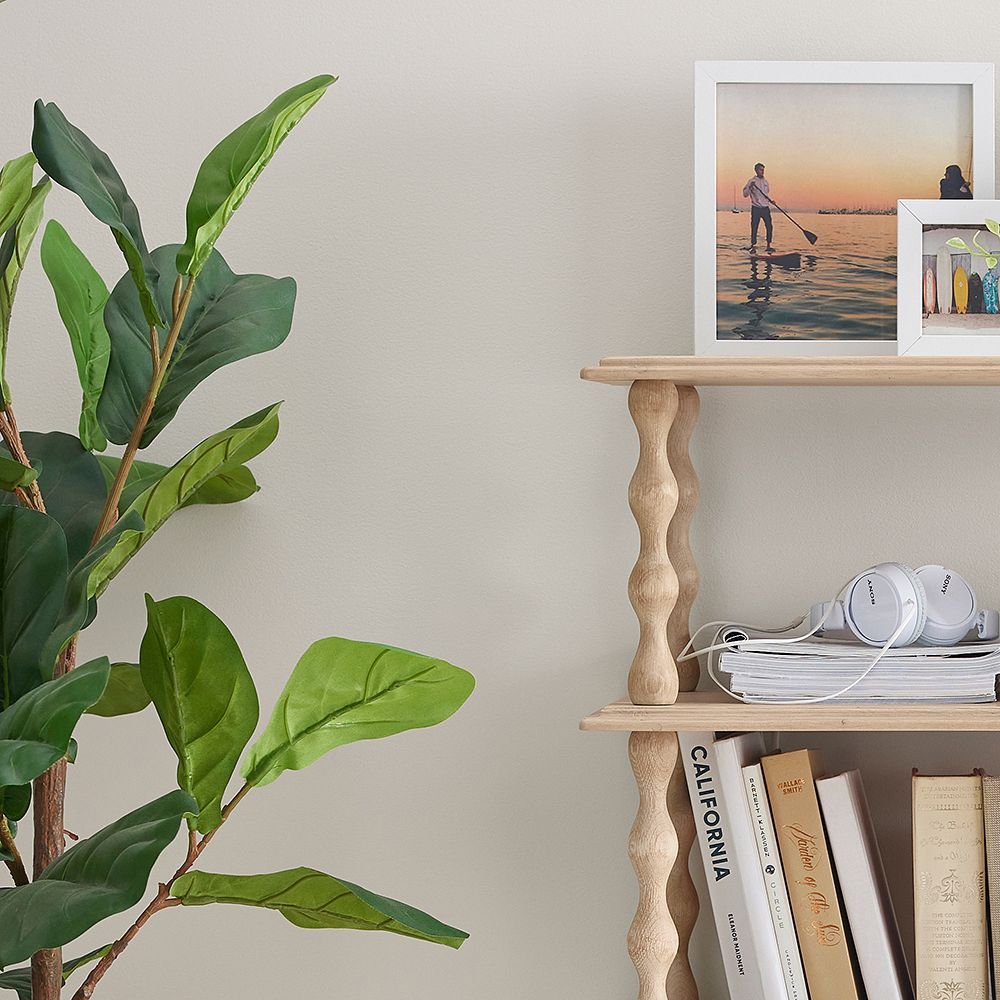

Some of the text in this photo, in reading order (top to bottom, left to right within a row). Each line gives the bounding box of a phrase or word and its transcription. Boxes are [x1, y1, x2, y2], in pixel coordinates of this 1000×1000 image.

[867, 579, 876, 605] SONY
[941, 574, 952, 595] SONY
[691, 745, 731, 882] CALIFORNIA
[783, 785, 803, 796] SMITH
[749, 778, 770, 857] BARNETT KLASSEN
[770, 881, 785, 929] CIRCLE
[727, 913, 745, 976] ELEANOR MAIDMENT
